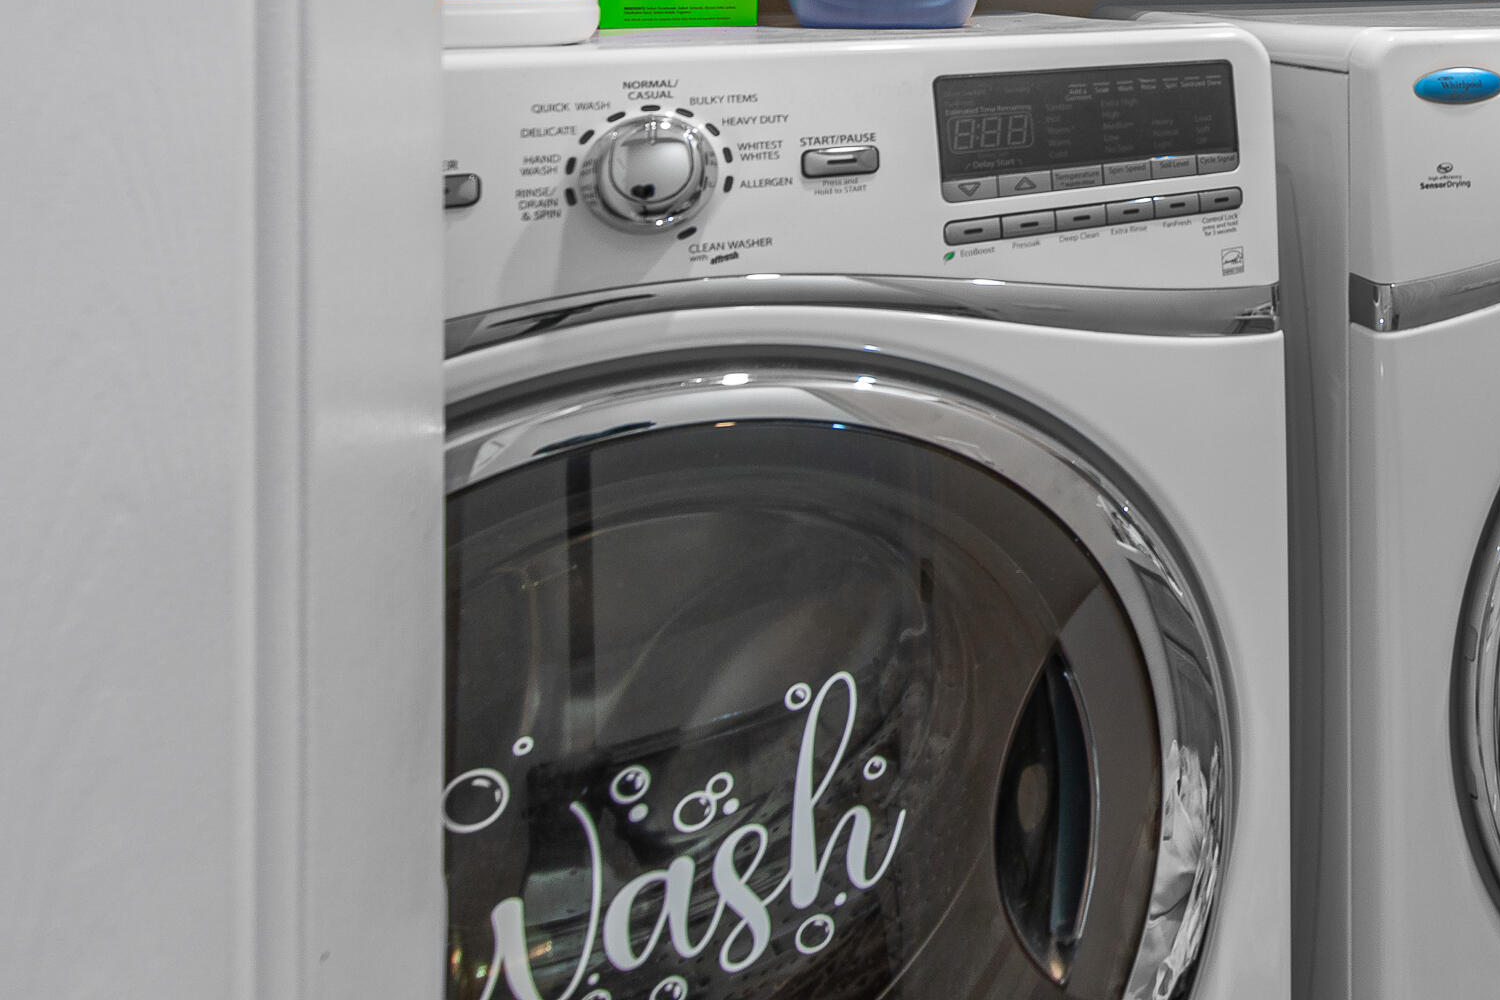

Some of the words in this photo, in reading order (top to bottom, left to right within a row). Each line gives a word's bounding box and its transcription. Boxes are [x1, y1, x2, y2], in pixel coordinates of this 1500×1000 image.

[622, 79, 679, 90] NORMAL/
[1440, 79, 1482, 91] Whirlpool
[627, 90, 674, 100] CASUAL
[689, 95, 725, 106] BULKY
[726, 93, 759, 103] ITEMS
[574, 101, 611, 111] WASH
[721, 116, 757, 126] HEAVY
[759, 114, 789, 124] DUTY
[799, 133, 877, 146] START/PAUSE
[737, 140, 784, 151] WHITEST
[739, 151, 781, 161] WHITES
[1200, 156, 1214, 164] Cycle
[1215, 154, 1235, 163] Signal
[1109, 167, 1124, 175] Spin
[1125, 164, 1146, 173] Speed
[739, 177, 793, 189] ALLERGEN
[822, 178, 843, 187] Press
[844, 177, 859, 186] and
[1419, 180, 1472, 191] SensorDrying
[814, 187, 833, 196] Hold
[843, 184, 867, 194] START
[1162, 218, 1193, 228] FanFresh
[1201, 215, 1225, 224] Control
[1225, 213, 1239, 221] Lock
[1110, 226, 1129, 236] Extra
[1130, 225, 1147, 233] Rinse
[1058, 234, 1079, 244] Deep
[1080, 231, 1100, 240] Clean
[688, 240, 726, 254] CLEAN
[726, 236, 773, 251] WASHER
[1011, 240, 1040, 249] Presoak
[959, 246, 996, 258] EcoBoost
[480, 671, 907, 1000] Wash
